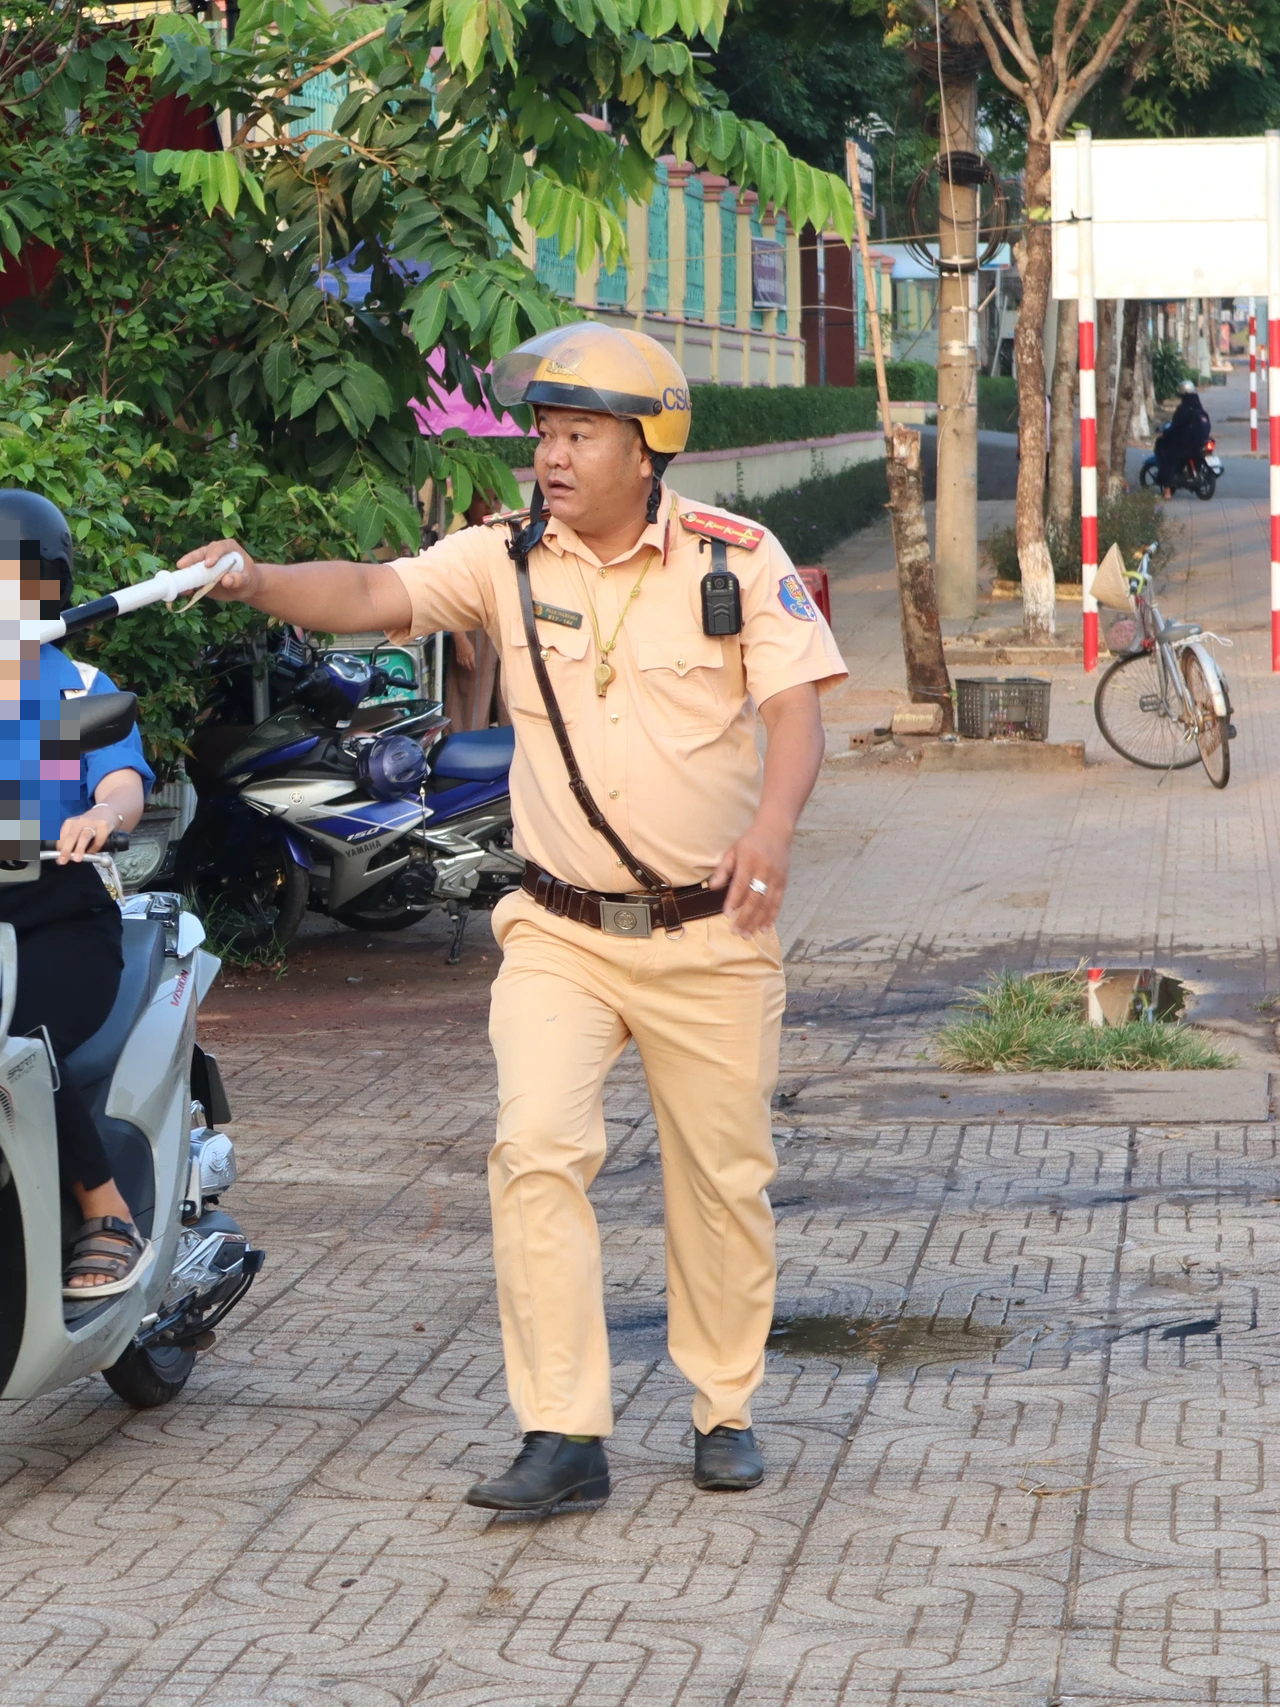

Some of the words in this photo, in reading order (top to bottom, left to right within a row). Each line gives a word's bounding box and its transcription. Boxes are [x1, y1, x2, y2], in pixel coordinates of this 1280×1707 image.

[346, 826, 381, 842] 150
[345, 841, 382, 858] YAMAHA
[170, 969, 189, 1006] VISION
